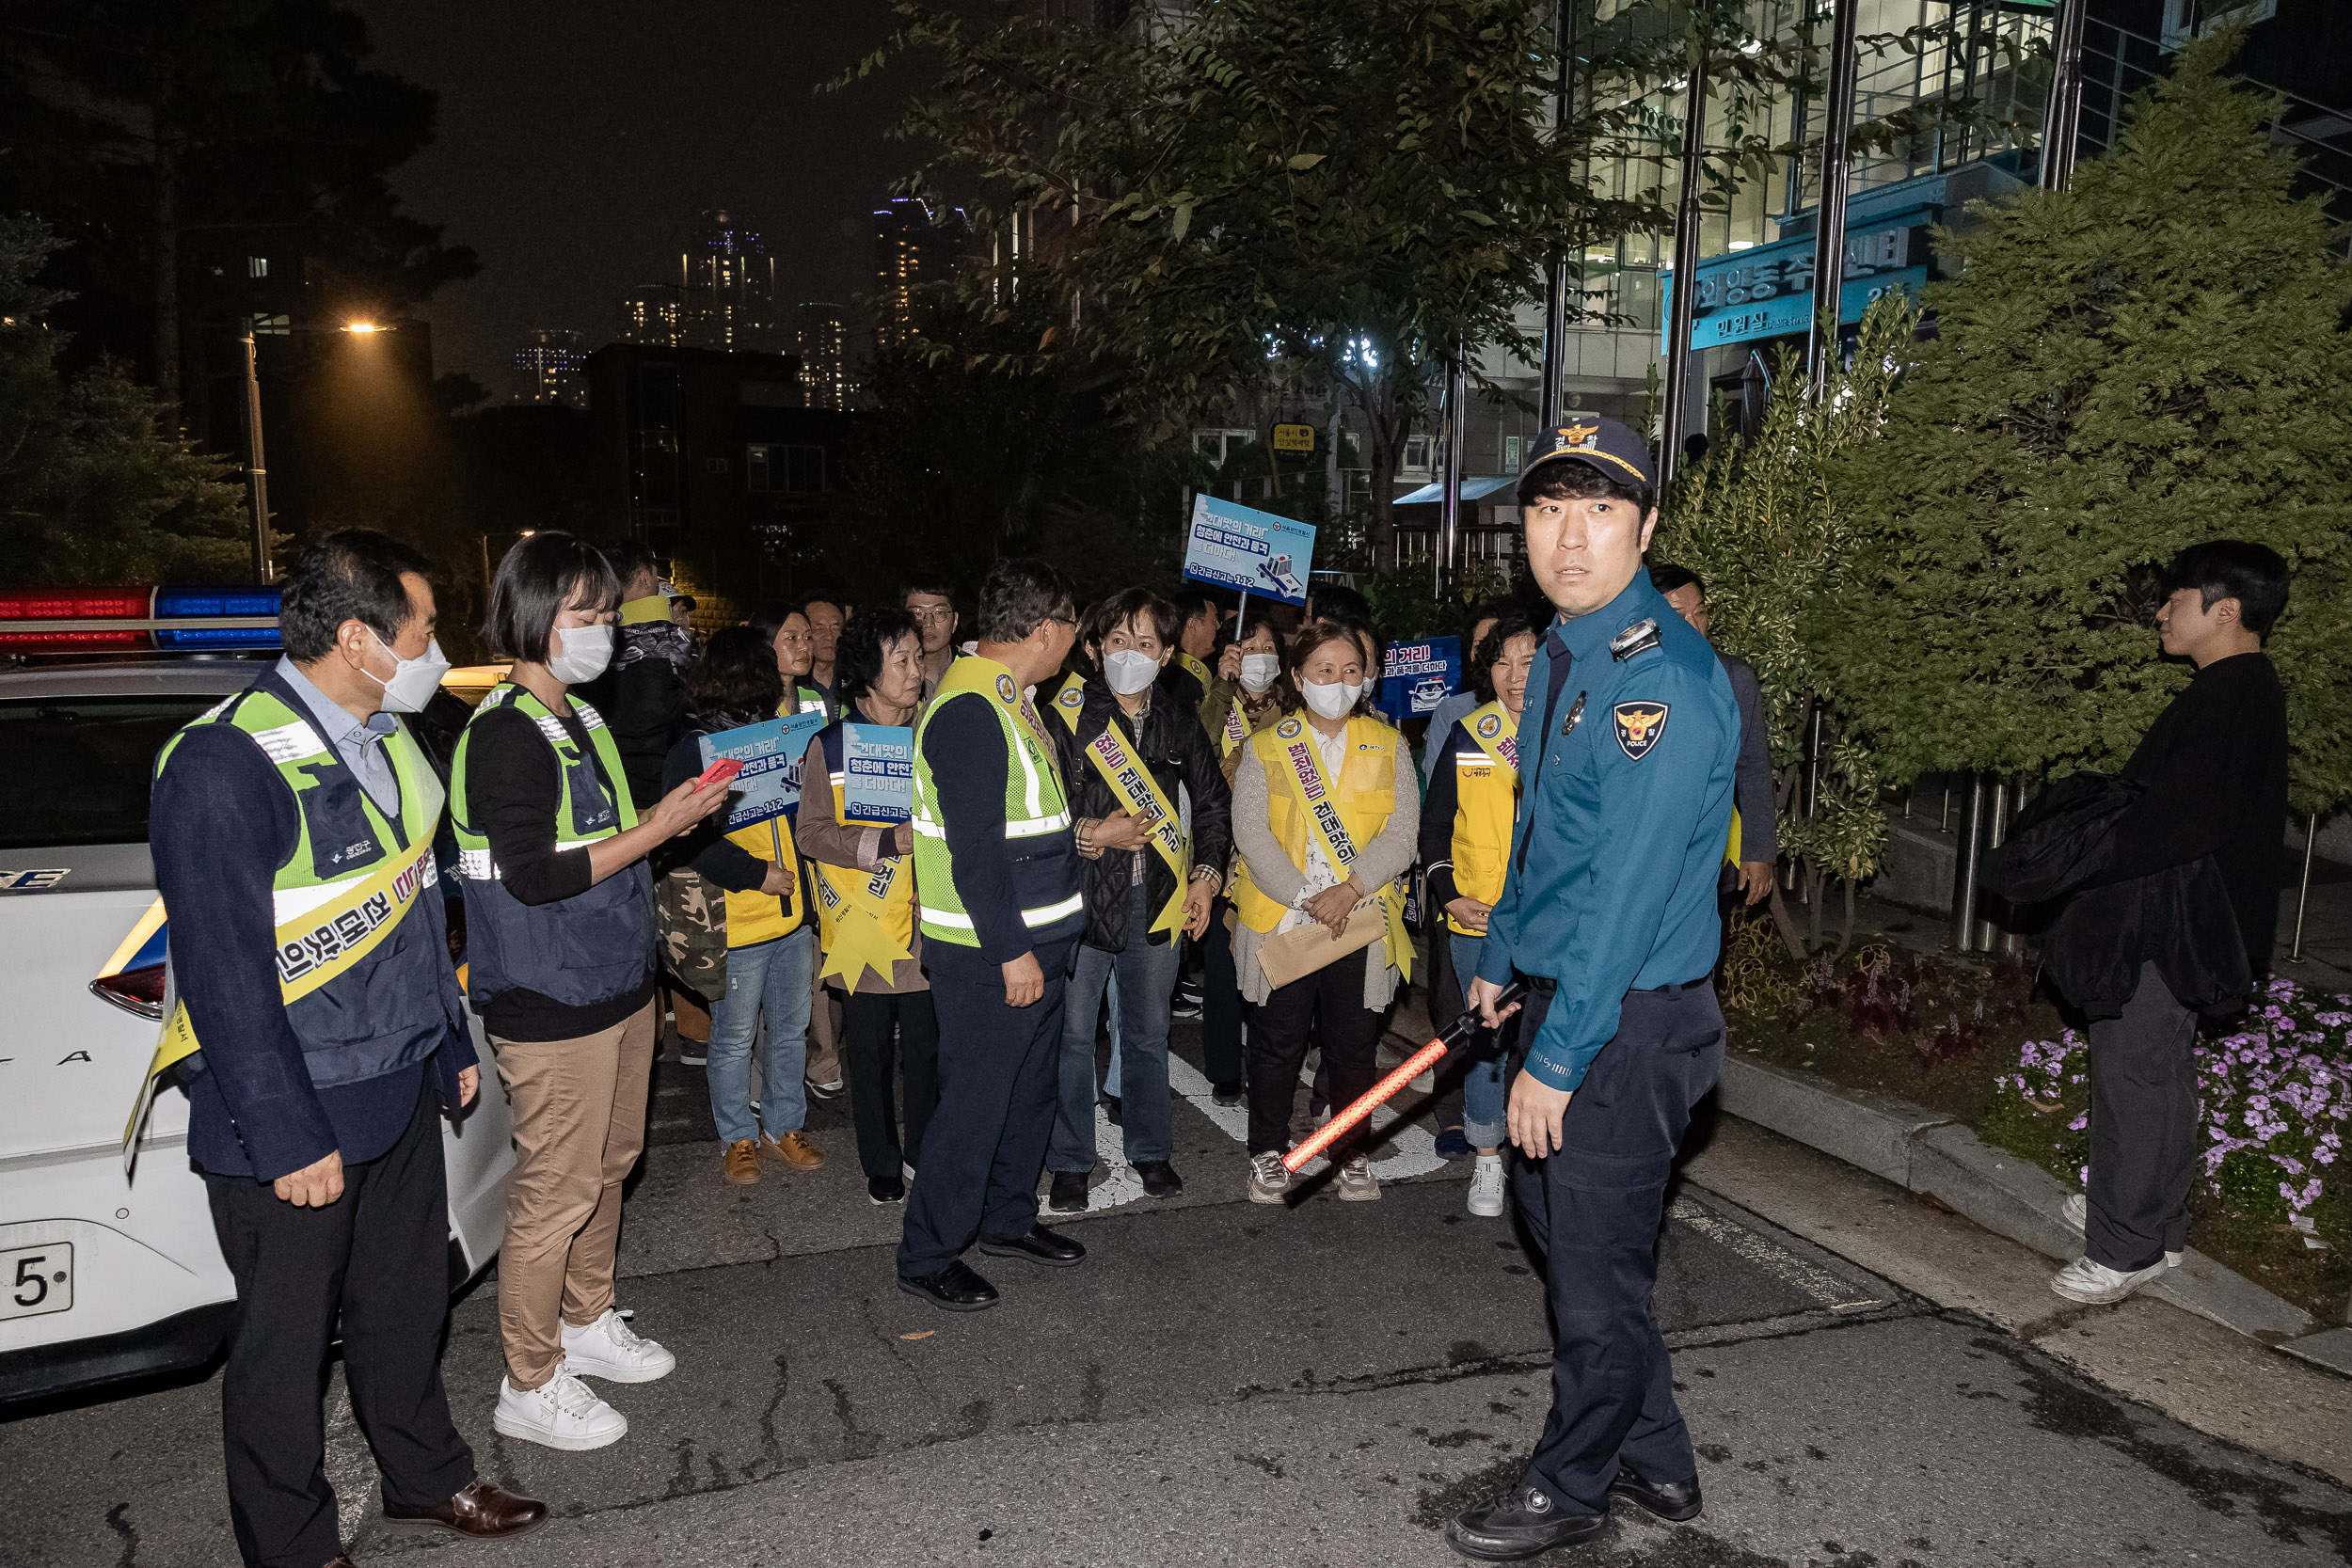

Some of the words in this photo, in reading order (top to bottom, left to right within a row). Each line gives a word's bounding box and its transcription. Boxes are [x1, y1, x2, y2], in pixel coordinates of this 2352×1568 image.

[1717, 311, 1768, 339] 민원실
[1196, 525, 1223, 543] 청춘에
[1224, 531, 1250, 549] 안전과
[1250, 541, 1268, 555] 품격
[1198, 567, 1234, 584] 긴급신고는
[1234, 575, 1255, 588] 112
[1399, 645, 1430, 663] 거리!
[1396, 663, 1421, 675] 품격을
[1422, 660, 1447, 673] 더하다
[741, 760, 768, 775] 안전과
[768, 754, 786, 769] 품격
[850, 759, 884, 774] 청춘에
[850, 775, 863, 789] 을
[728, 805, 764, 825] 긴급신고는
[763, 798, 784, 814] 112
[862, 805, 910, 818] 긴급신고는
[1287, 741, 1327, 802] 범죄없는
[1312, 800, 1359, 866] 건대맛의
[1157, 820, 1180, 854] 거리
[277, 891, 393, 984] 건대맛의
[13, 1257, 48, 1307] 5
